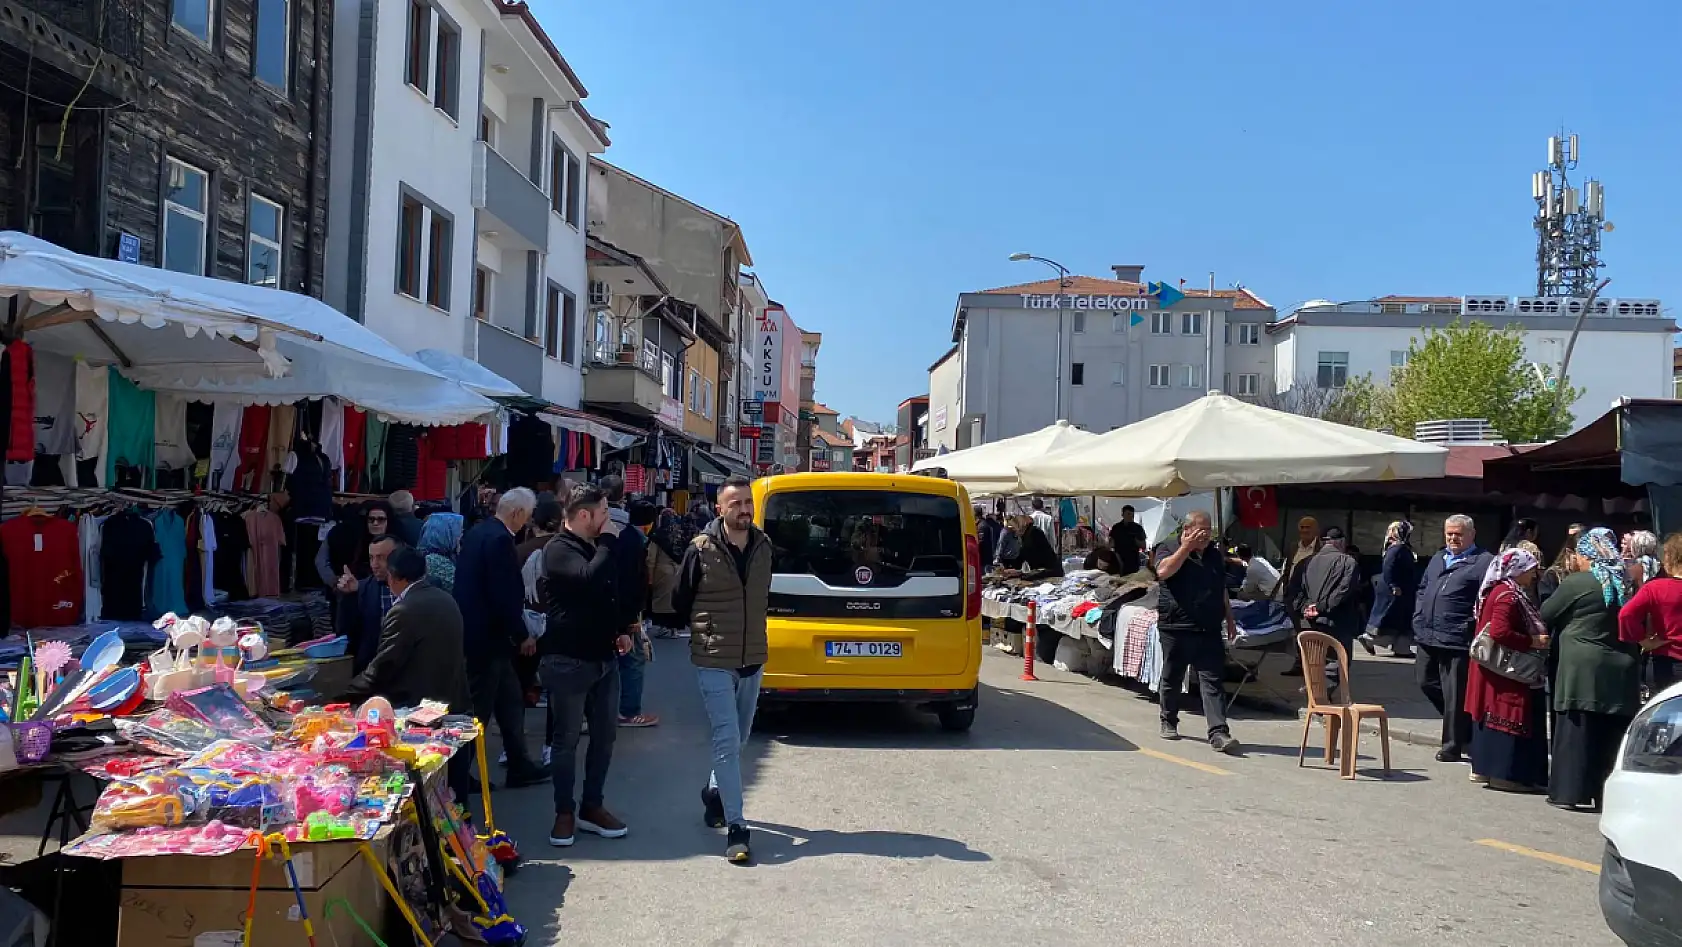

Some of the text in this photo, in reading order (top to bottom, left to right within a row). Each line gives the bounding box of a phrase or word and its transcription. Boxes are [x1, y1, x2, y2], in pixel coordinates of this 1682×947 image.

[1021, 294, 1148, 310] Türk Telekom
[836, 643, 851, 654] 74
[855, 643, 863, 654] T
[869, 643, 900, 654] 0129
